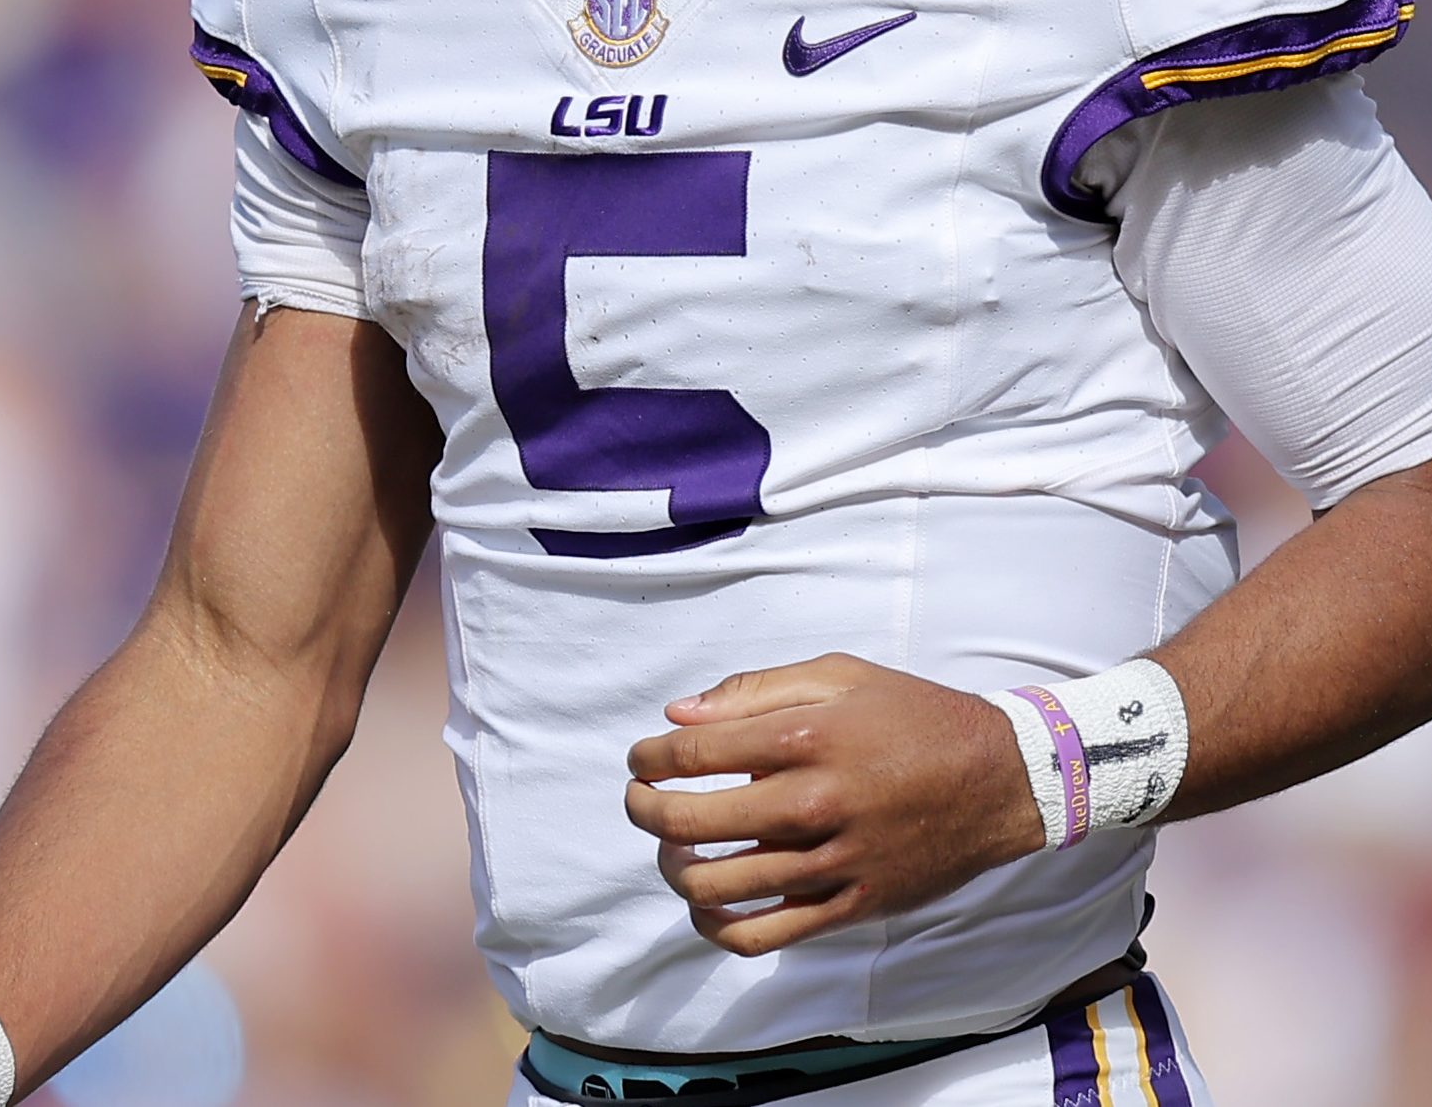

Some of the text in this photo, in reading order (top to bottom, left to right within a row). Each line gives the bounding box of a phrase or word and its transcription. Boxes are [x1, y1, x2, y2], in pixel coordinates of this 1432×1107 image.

[579, 32, 655, 64] GRADUATE
[550, 94, 668, 137] LSU
[482, 150, 772, 559] 5
